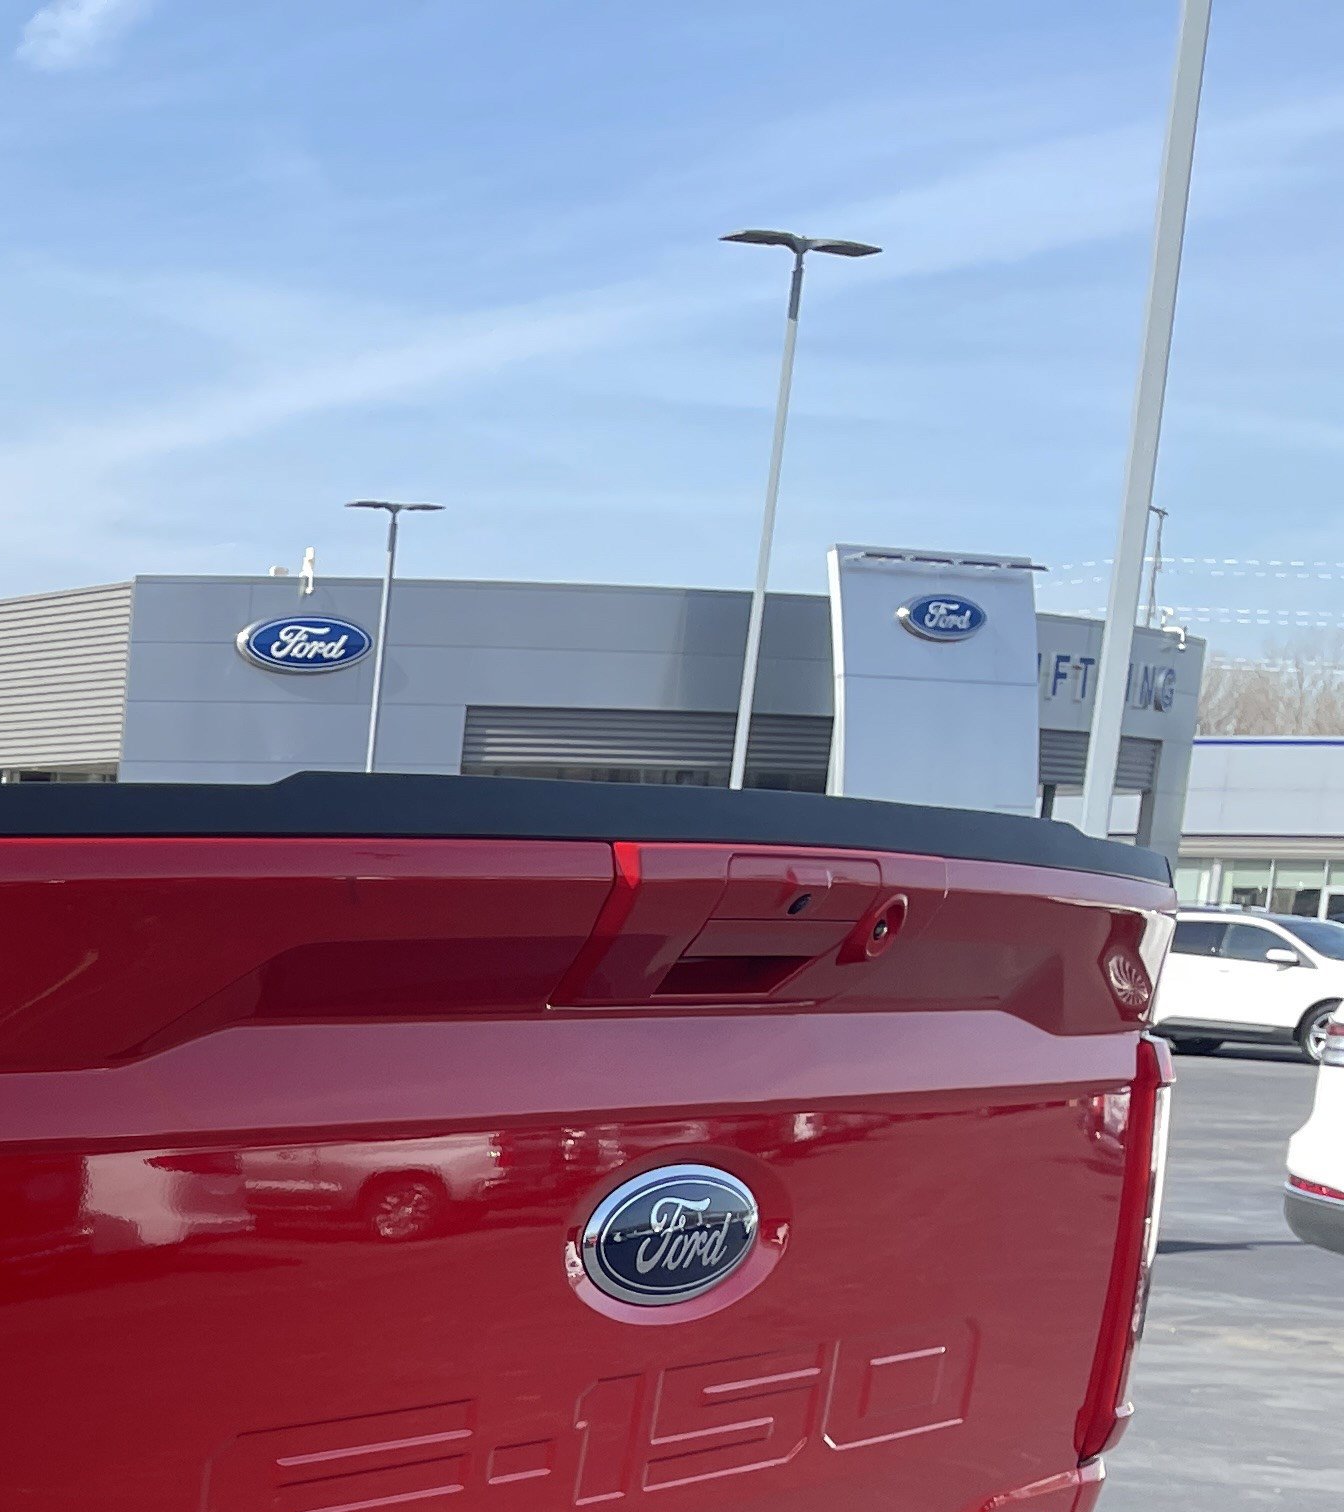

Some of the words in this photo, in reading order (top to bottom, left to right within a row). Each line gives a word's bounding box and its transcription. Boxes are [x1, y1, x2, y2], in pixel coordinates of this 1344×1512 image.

[924, 601, 971, 629] Ford
[270, 625, 348, 660] Ford
[635, 1197, 733, 1275] Ford
